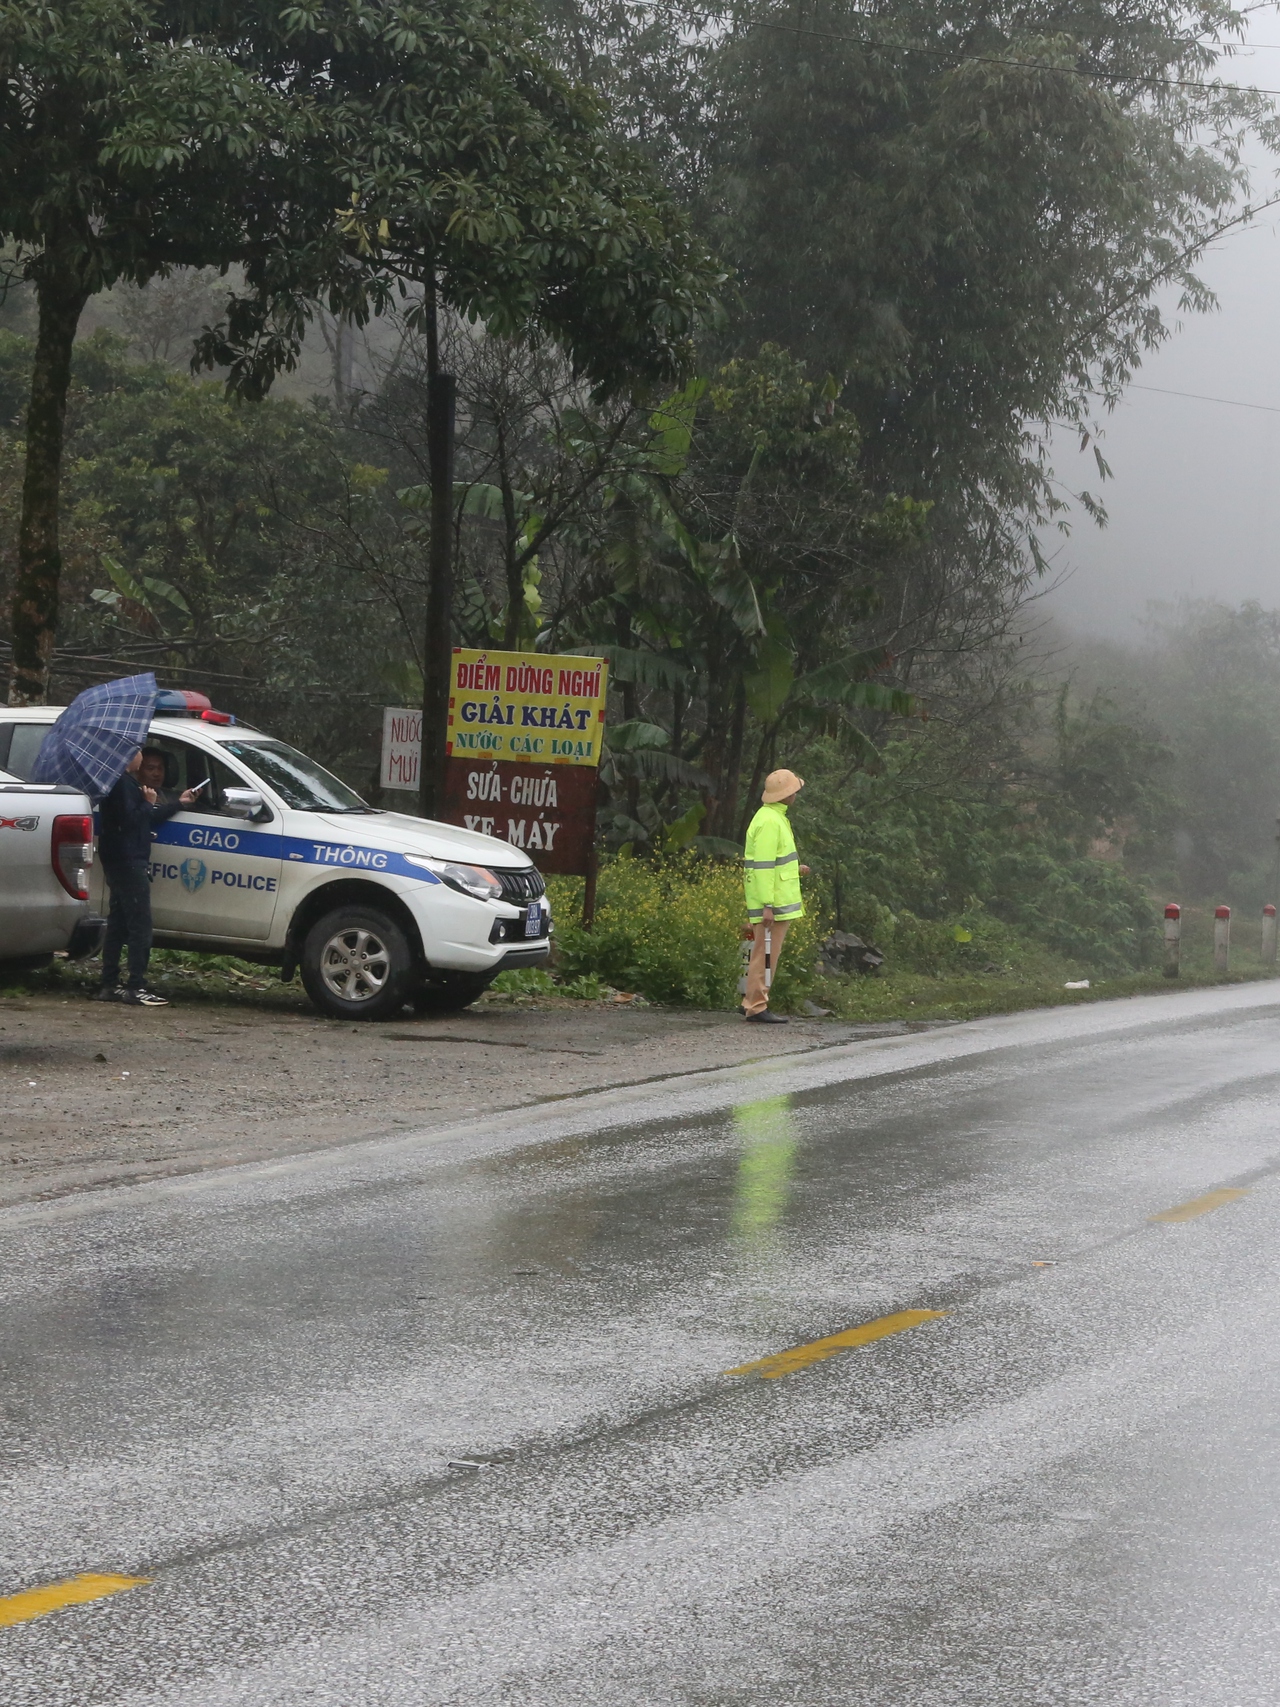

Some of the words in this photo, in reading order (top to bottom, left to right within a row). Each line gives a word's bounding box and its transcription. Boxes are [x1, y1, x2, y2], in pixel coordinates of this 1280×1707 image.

[457, 654, 501, 691] ĐIỂM
[506, 662, 553, 694] DỪNG
[558, 663, 602, 698] NGHỈ
[461, 695, 515, 725] GIẢI
[521, 703, 591, 731] KHÁT
[456, 730, 503, 750] NƯỚC
[510, 734, 544, 753] CÁC
[551, 739, 593, 761] LOẠI
[188, 829, 240, 849] GIAO
[313, 845, 388, 868] THÔNG
[211, 870, 277, 892] POLICE
